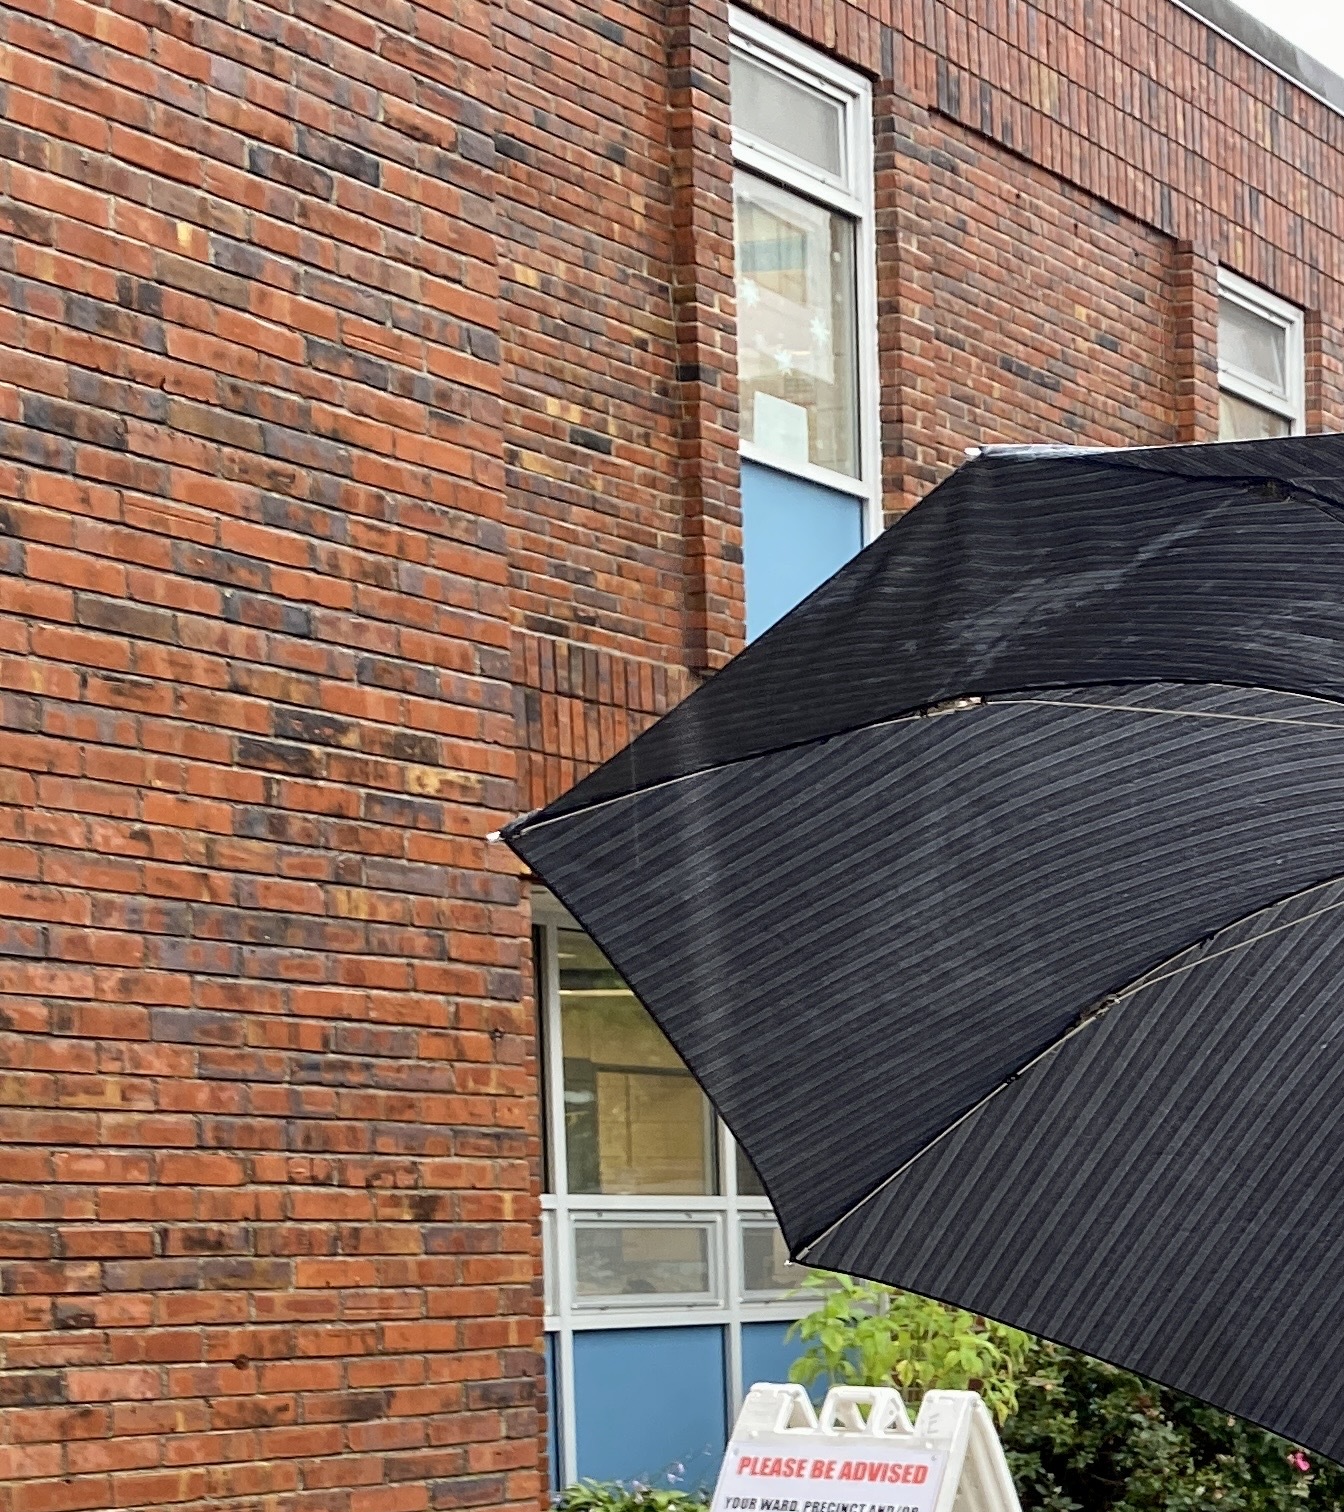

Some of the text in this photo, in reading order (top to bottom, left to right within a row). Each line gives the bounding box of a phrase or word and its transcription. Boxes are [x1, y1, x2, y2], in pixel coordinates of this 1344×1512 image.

[737, 1456, 929, 1484] PLEASE BE ADVISED
[725, 1497, 756, 1510] YOUR
